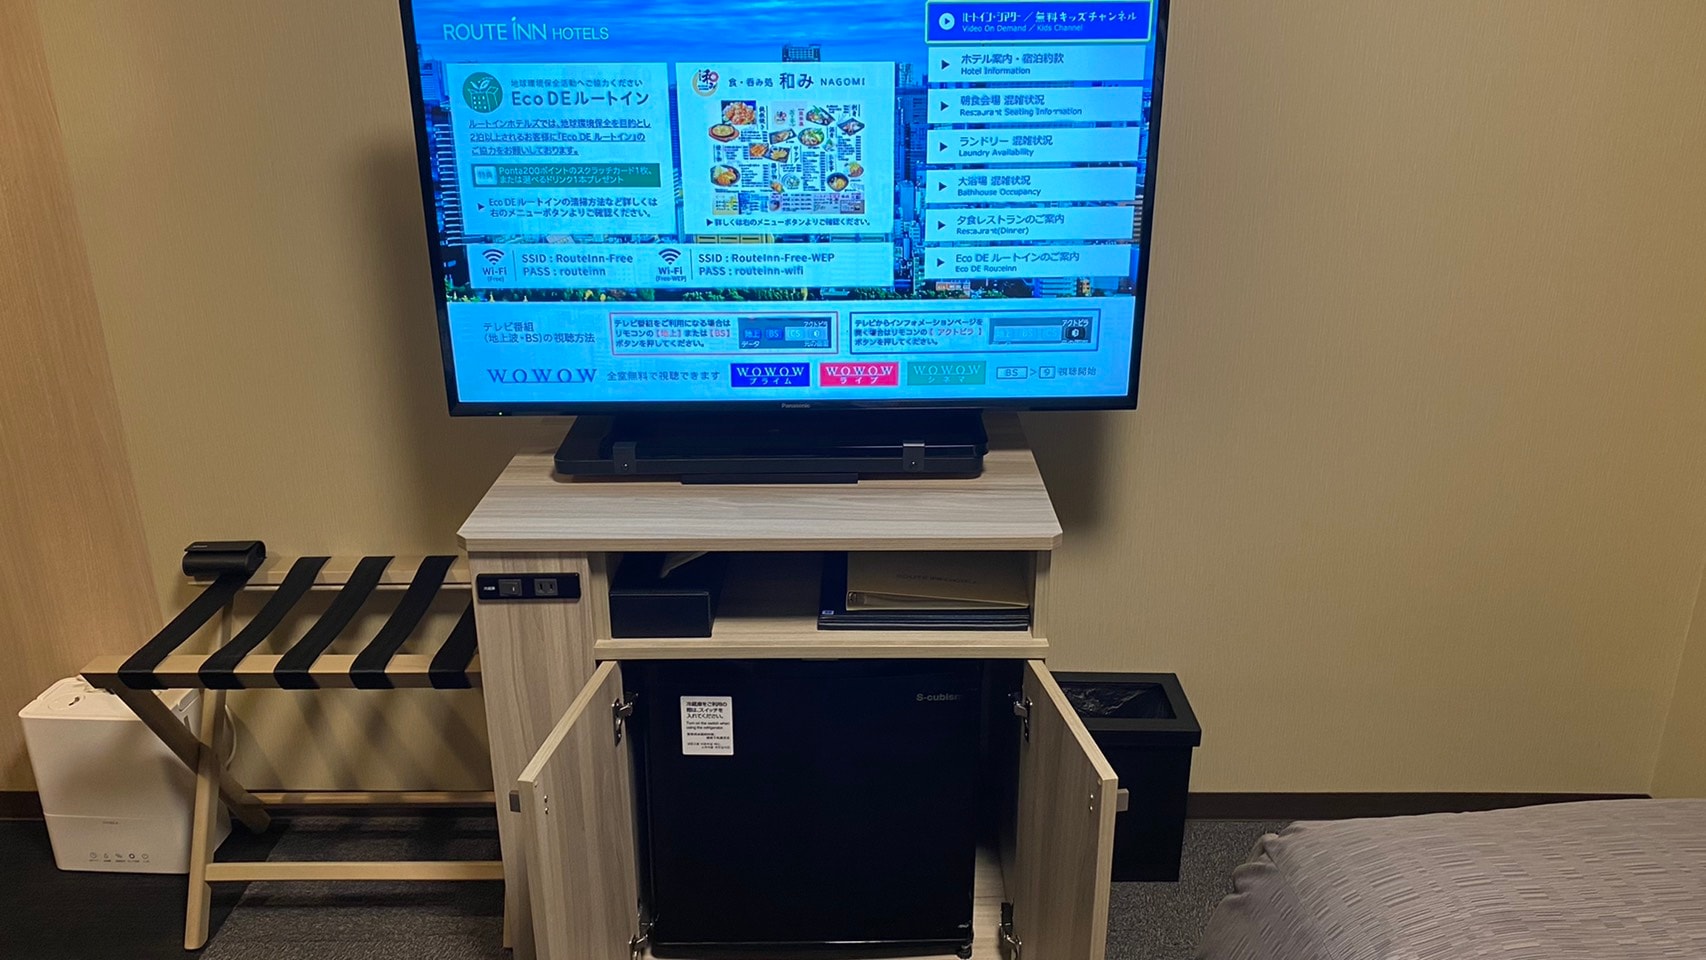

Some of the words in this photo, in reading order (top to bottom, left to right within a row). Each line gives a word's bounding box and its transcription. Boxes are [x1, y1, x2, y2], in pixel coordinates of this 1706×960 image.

[1035, 11, 1137, 23] 無料キッズチャンネル
[443, 23, 508, 41] ROUTE
[511, 16, 548, 41] INN
[552, 27, 609, 40] HOTELS
[1053, 24, 1084, 32] Channel
[961, 53, 1065, 65] ホテル案内・宿泊約款
[961, 67, 982, 75] Hotel
[983, 67, 1031, 75] Information
[779, 72, 815, 90] 和み
[820, 77, 866, 87] NAGOMI
[512, 91, 544, 106] Eco
[960, 95, 1001, 106] 朝食会場
[1004, 94, 1045, 105] 混雑状況
[1004, 107, 1034, 117] Seating
[1035, 107, 1082, 116] Information
[959, 137, 1009, 147] ランドリー
[1012, 135, 1053, 146] 混雑状況
[958, 149, 990, 158] Laundry
[991, 148, 1035, 158] Availability
[957, 176, 988, 186] 大浴場
[991, 175, 1031, 186] 混雑状況
[957, 188, 997, 196] Bathhouse
[999, 188, 1041, 197] Occupancy
[957, 214, 1065, 225] 夕食レストランのご案内
[522, 254, 547, 263] SSID
[556, 254, 633, 264] RouteInn-Free
[698, 254, 723, 263] SSID
[731, 253, 835, 263] RouteInn-Free-WEP
[956, 254, 973, 263] Eco
[482, 267, 507, 276] Wi-Fi
[523, 267, 550, 276] PASS
[560, 267, 606, 276] routeinn
[658, 266, 683, 275] Wi-Fi
[699, 267, 726, 276] PASS
[735, 266, 804, 276] routeinn-wifi
[483, 322, 534, 332] テレビ番組
[614, 319, 731, 327] テレビ番組をご利用になる場合は
[855, 318, 983, 327] テレビからインフォメーションページを
[1061, 319, 1089, 327] アクトビラ
[855, 338, 938, 346] ボタンを押してください。
[736, 366, 805, 377] WOWOW
[825, 366, 894, 377] WOWOW
[912, 364, 981, 376] WOWOW
[1005, 368, 1018, 377] BS
[1044, 368, 1051, 377] 9
[1058, 366, 1097, 376] 視聴開始
[486, 368, 597, 384] WOWOW
[607, 371, 720, 381] 全室無料で視聴できます
[840, 377, 878, 385] ライブ
[750, 377, 792, 386] プライム
